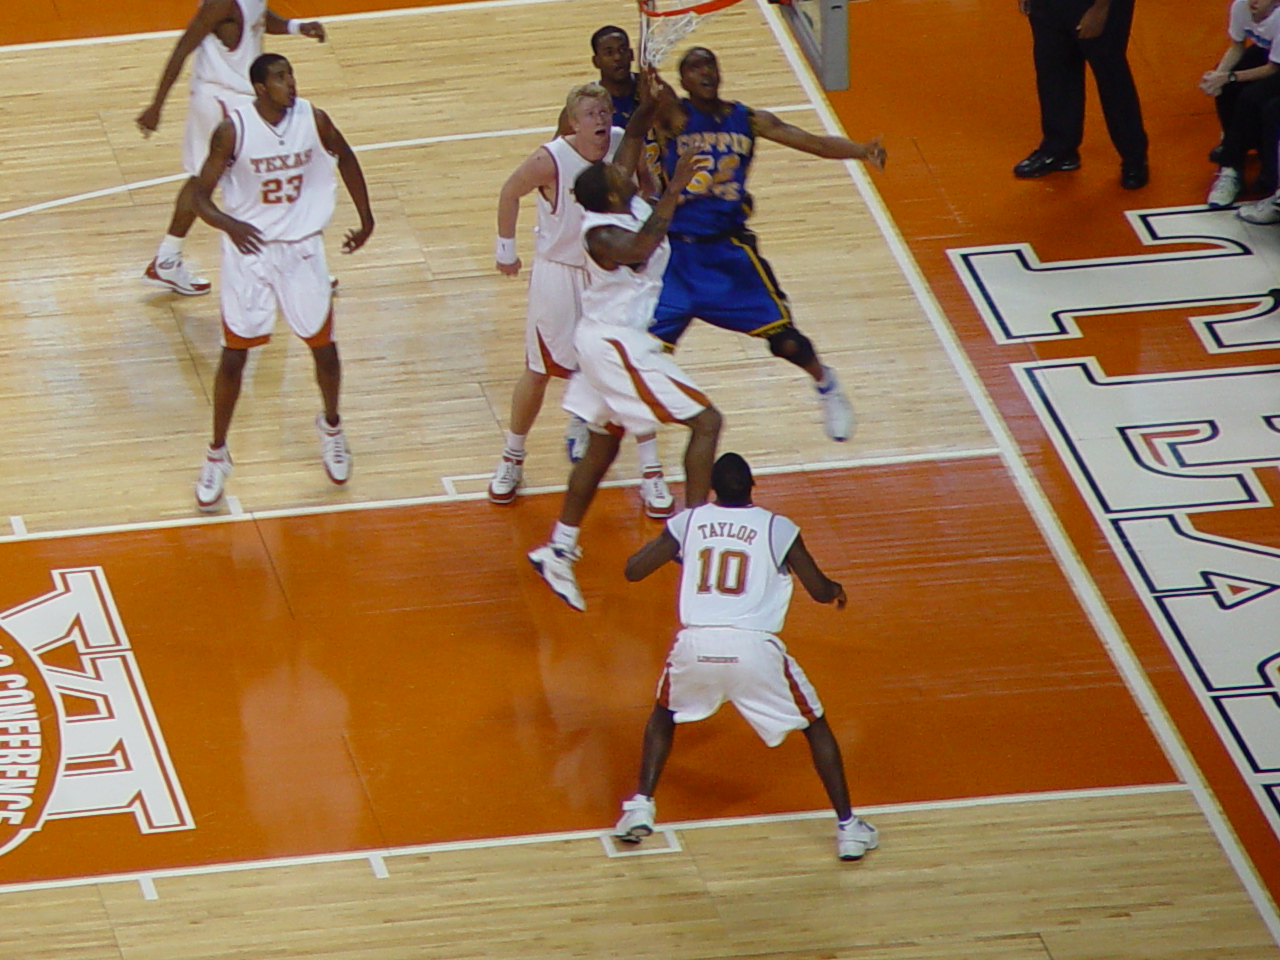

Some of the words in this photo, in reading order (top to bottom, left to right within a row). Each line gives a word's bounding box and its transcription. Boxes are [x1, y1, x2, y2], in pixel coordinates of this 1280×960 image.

[249, 148, 313, 175] TEXAS
[261, 174, 304, 205] 23
[697, 522, 758, 546] TAYLOR
[696, 546, 751, 597] 10
